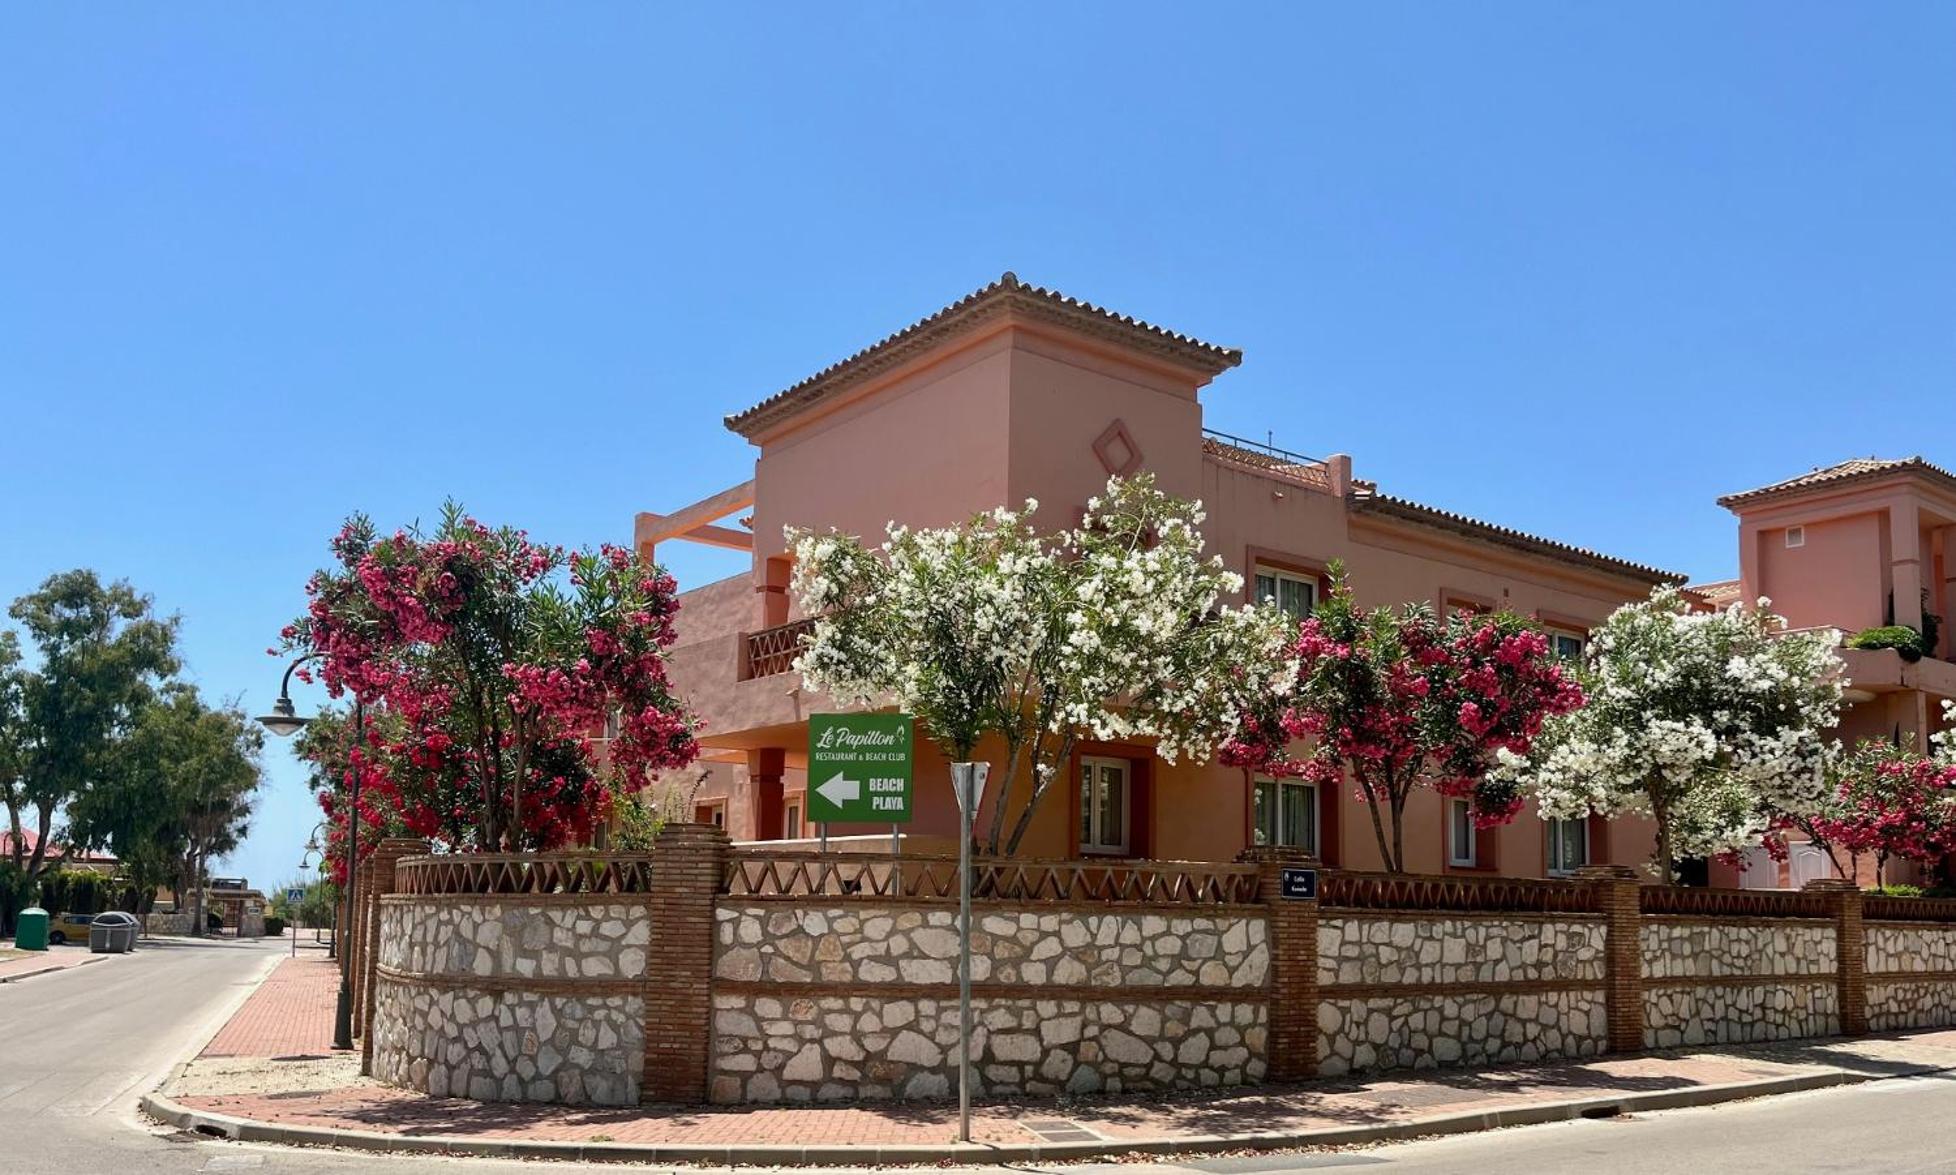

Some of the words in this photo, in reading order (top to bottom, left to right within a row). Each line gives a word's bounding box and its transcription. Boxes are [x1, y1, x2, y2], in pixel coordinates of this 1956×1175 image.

[816, 726, 834, 748] Le
[836, 727, 895, 750] Papillon
[815, 752, 857, 761] RESTAURANT
[866, 753, 887, 761] BEACH
[888, 753, 906, 761] CLUB
[869, 778, 904, 792] BEACH
[872, 796, 904, 811] PLAYA
